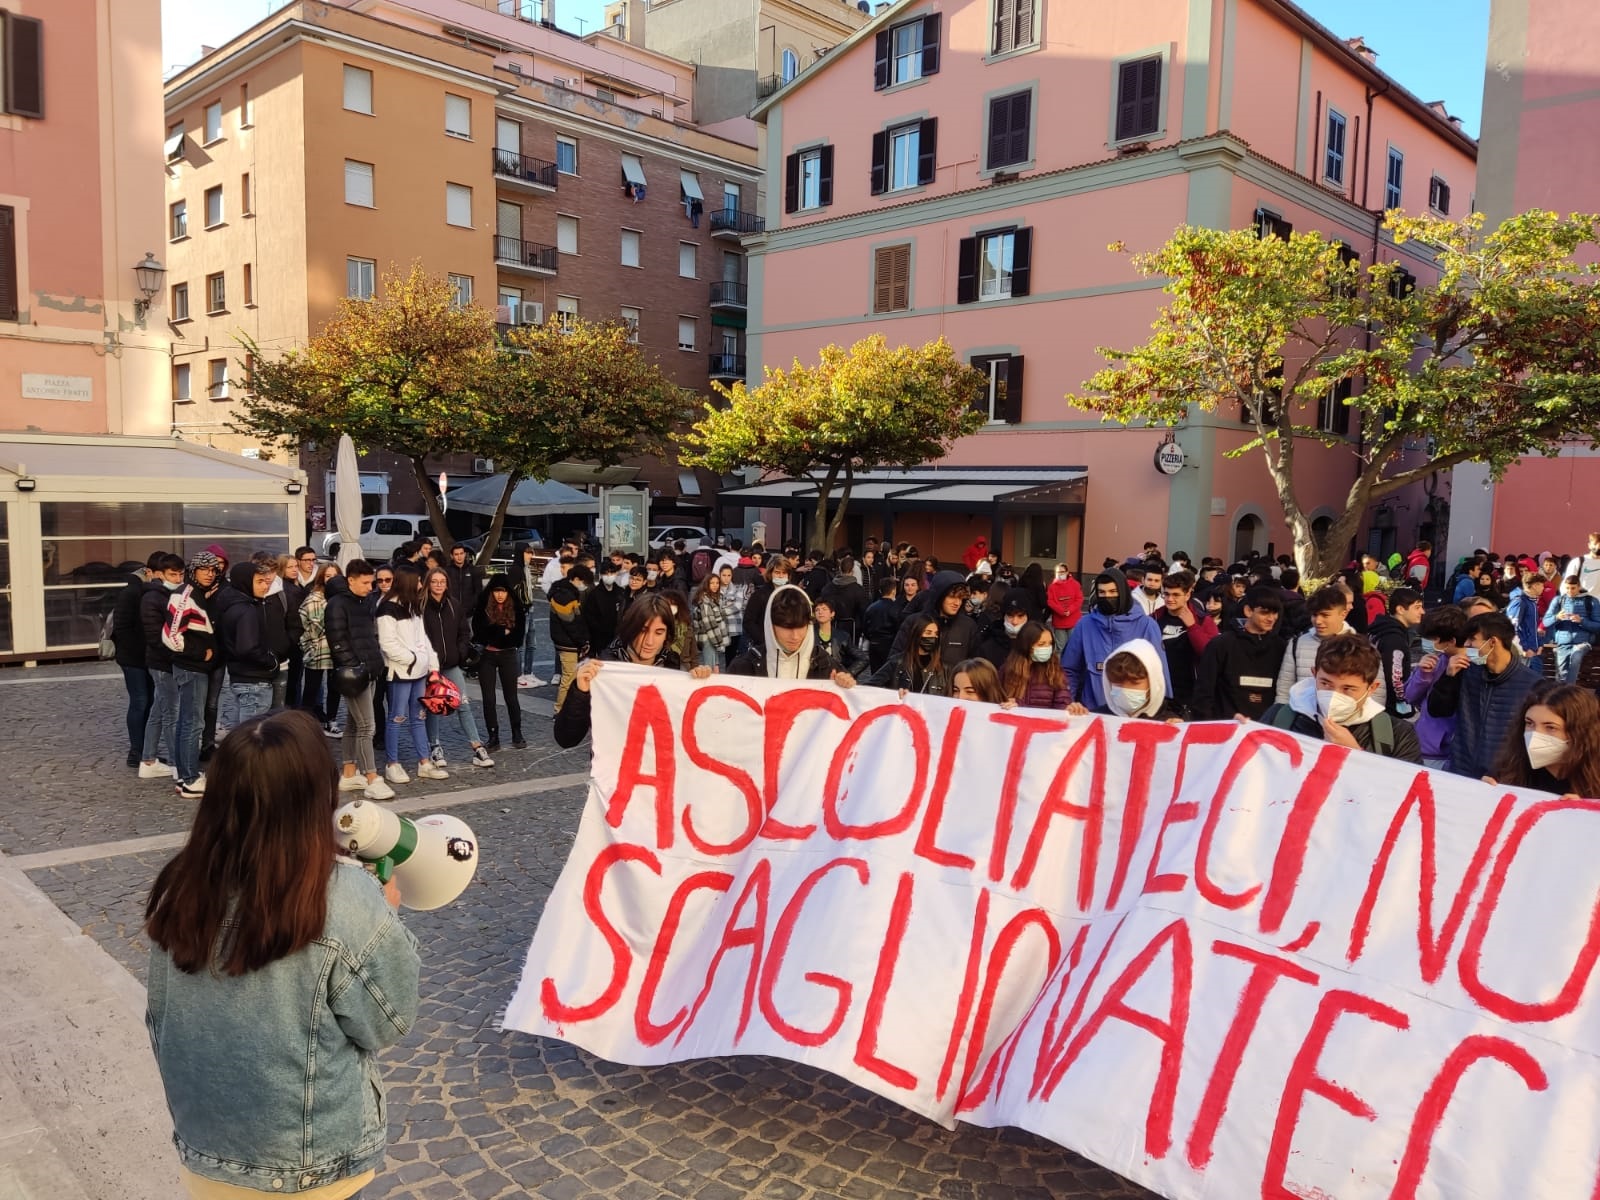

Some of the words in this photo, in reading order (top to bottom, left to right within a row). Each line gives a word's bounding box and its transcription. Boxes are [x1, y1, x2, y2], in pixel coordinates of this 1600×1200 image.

[44, 378, 70, 386] PIAZZA
[1160, 453, 1183, 464] PIZZERIA
[540, 842, 1600, 1200] SCAGLIONATEC
